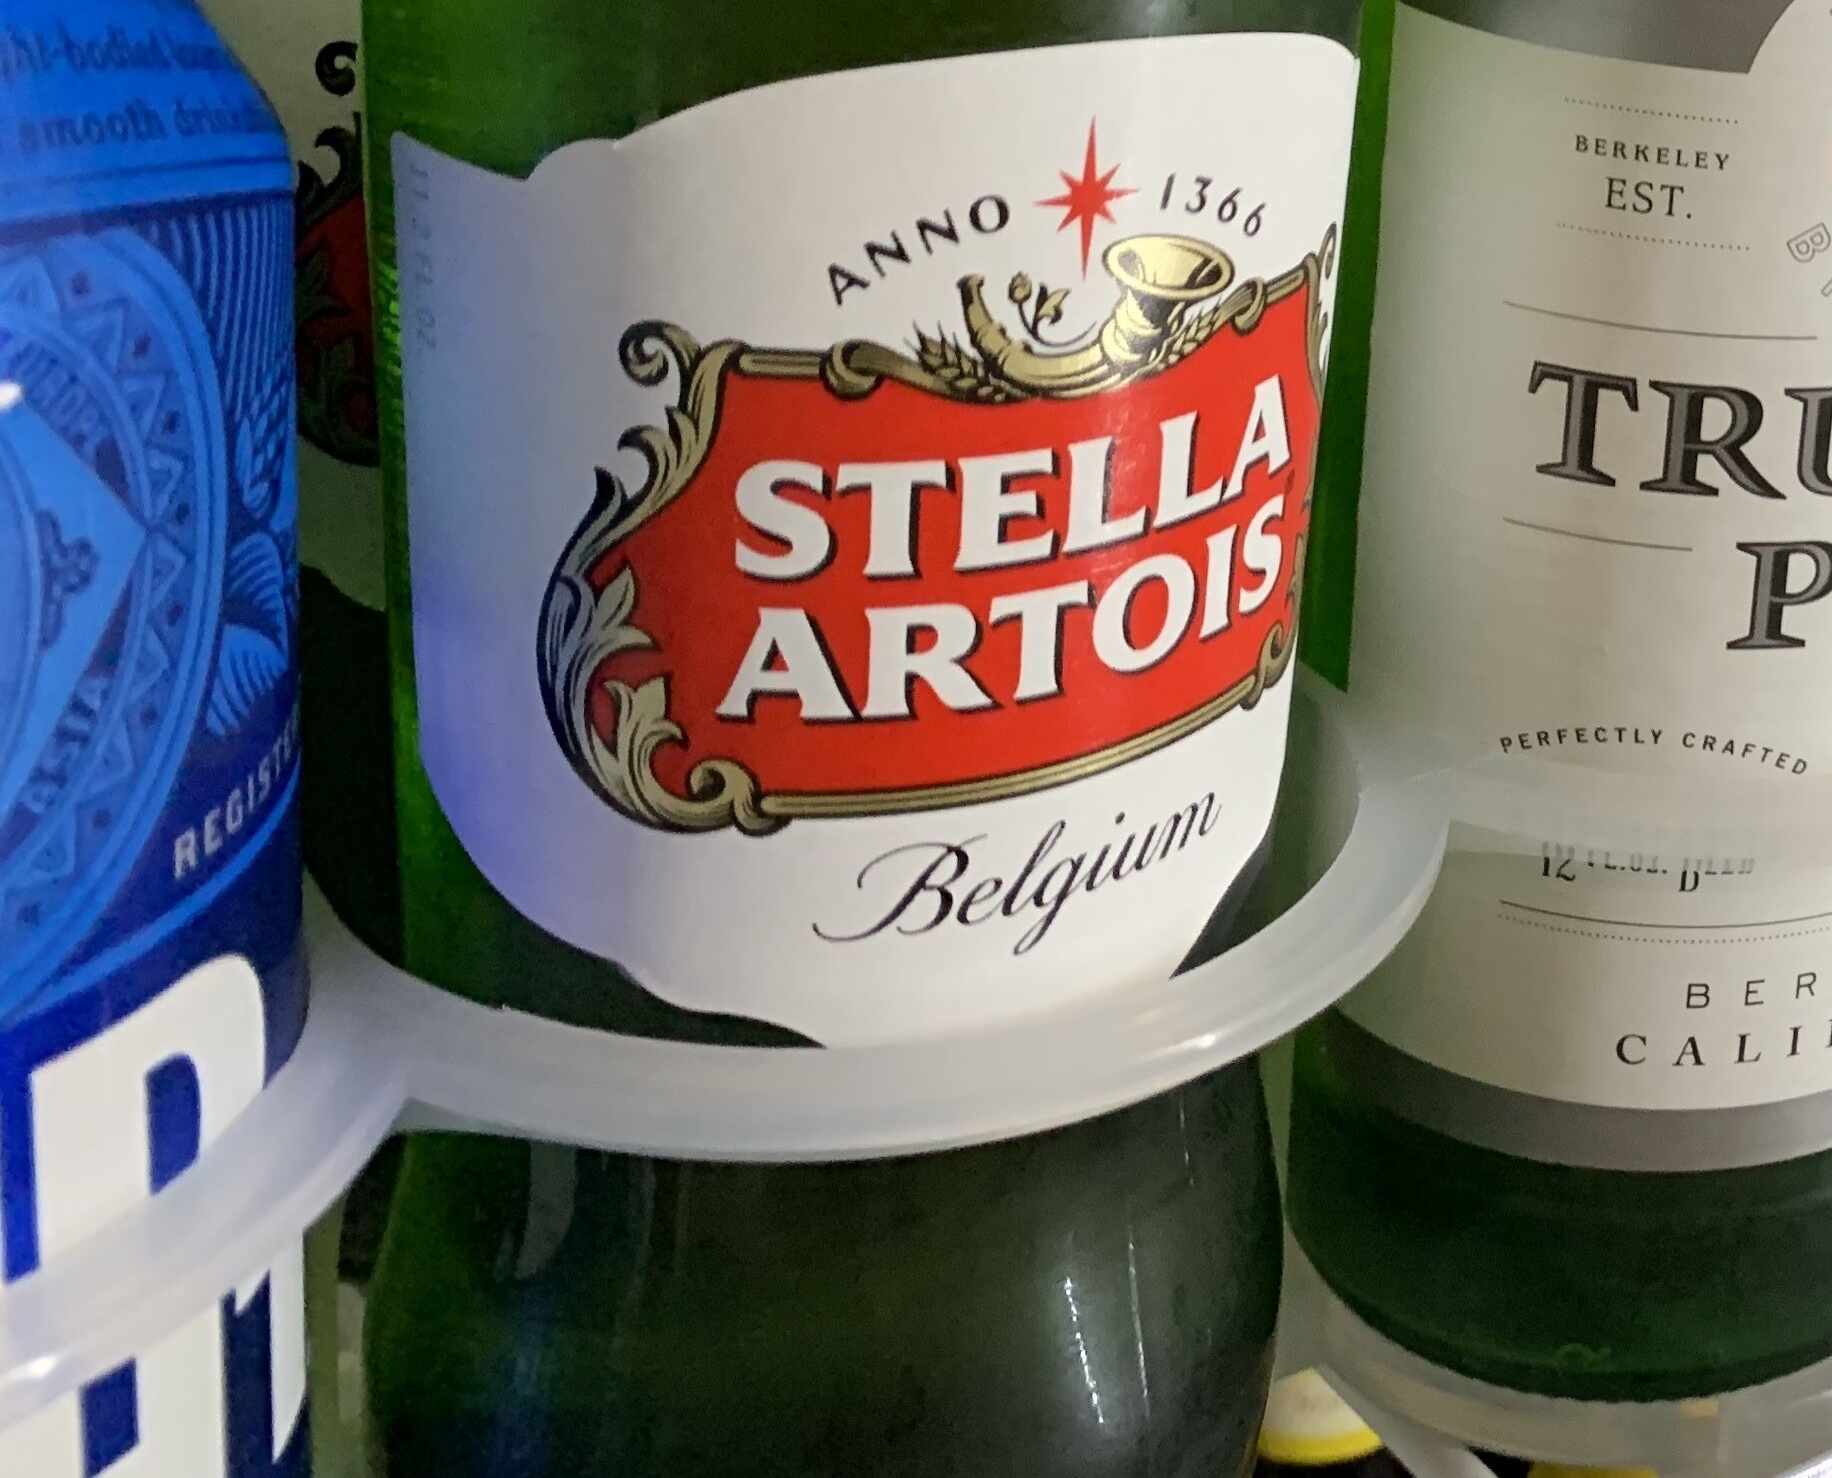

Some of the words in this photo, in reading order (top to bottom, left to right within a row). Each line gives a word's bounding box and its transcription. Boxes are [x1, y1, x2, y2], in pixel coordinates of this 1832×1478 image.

[1573, 133, 1733, 172] BERKELEY
[1158, 172, 1268, 239] 1366
[1603, 176, 1695, 220] EST.
[824, 194, 1011, 306] ANNO
[732, 373, 1297, 583] STELLA
[714, 492, 1286, 723] ARTOIS
[1499, 725, 1664, 753] PERFECTLY
[1681, 731, 1809, 776] CRAFTED
[811, 790, 1222, 956] Belgium
